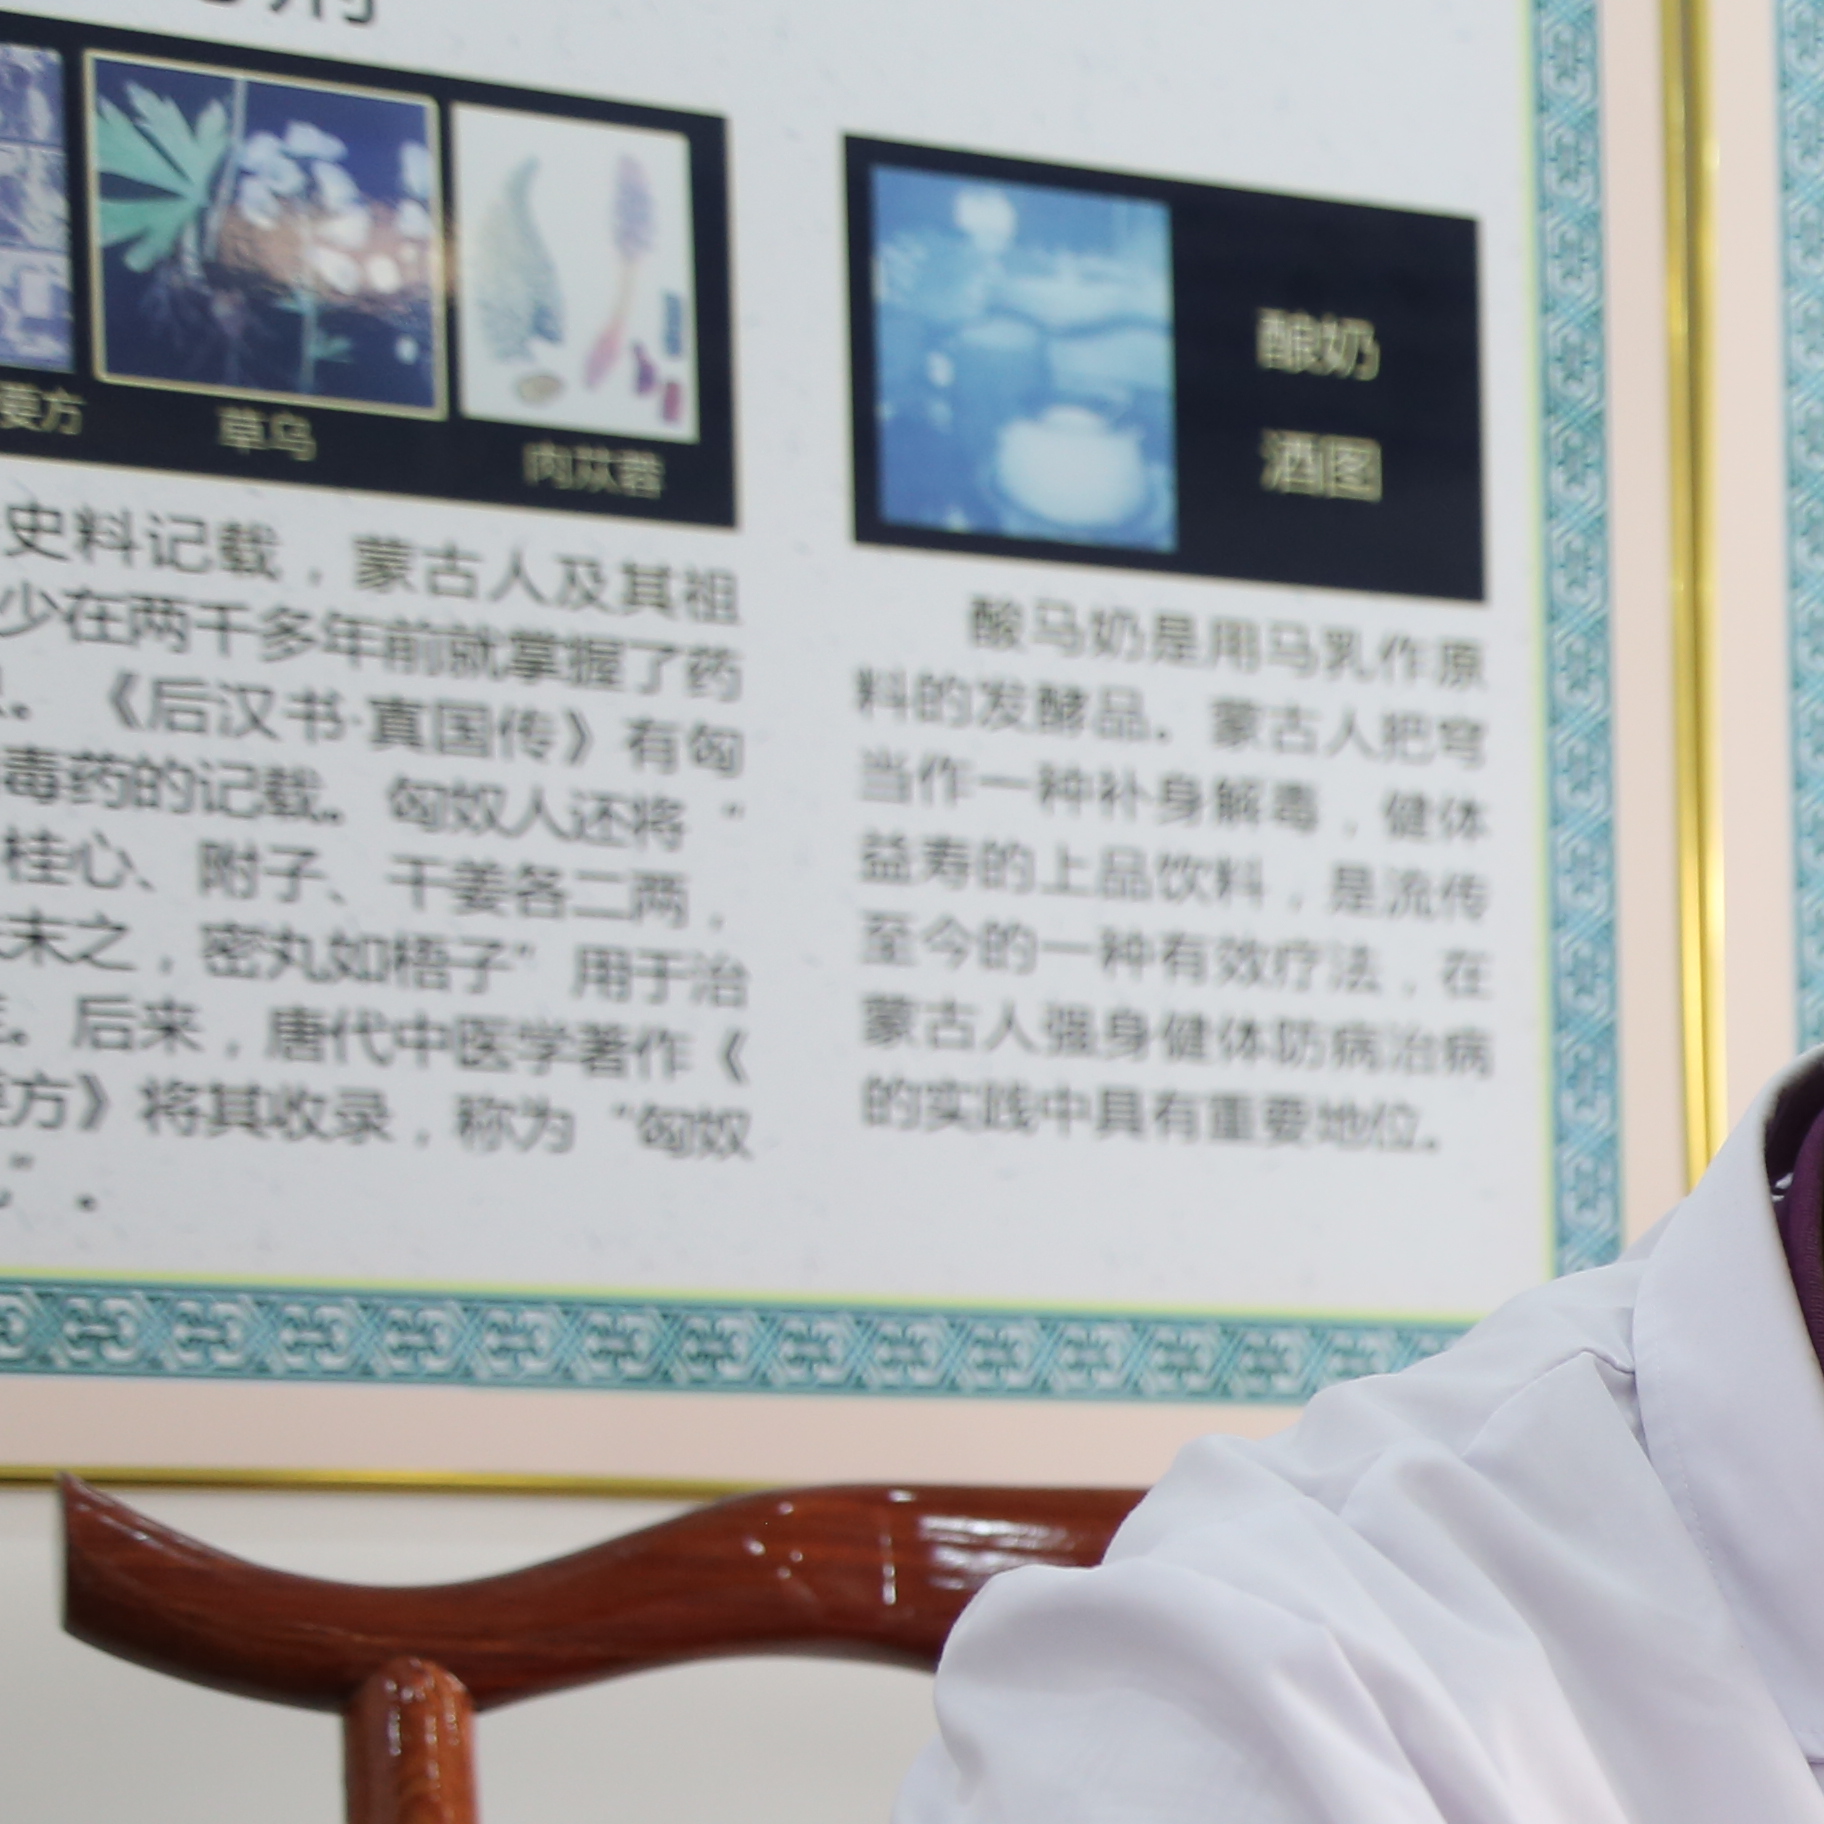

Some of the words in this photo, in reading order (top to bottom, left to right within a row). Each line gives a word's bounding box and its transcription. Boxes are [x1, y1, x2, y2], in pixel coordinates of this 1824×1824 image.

[217, 405, 317, 461] 草乌
[1261, 428, 1383, 503] 酒图
[969, 594, 1490, 692] 酸马奶是用马乳作原
[859, 746, 1491, 845] 当作一种补身解毒，健体
[858, 830, 1491, 925] 益寿的上品饮料，是流传
[859, 910, 1492, 1002] 至今的一种有效疗法，在
[0, 993, 748, 1086] 。后来，唐代中医学著作《
[860, 990, 1495, 1081] 蒙古人强身健体防病治病
[0, 1069, 754, 1160] 方》将其收录，称为“匈奴
[860, 1074, 1440, 1154] 的实践中具有重要地位。
